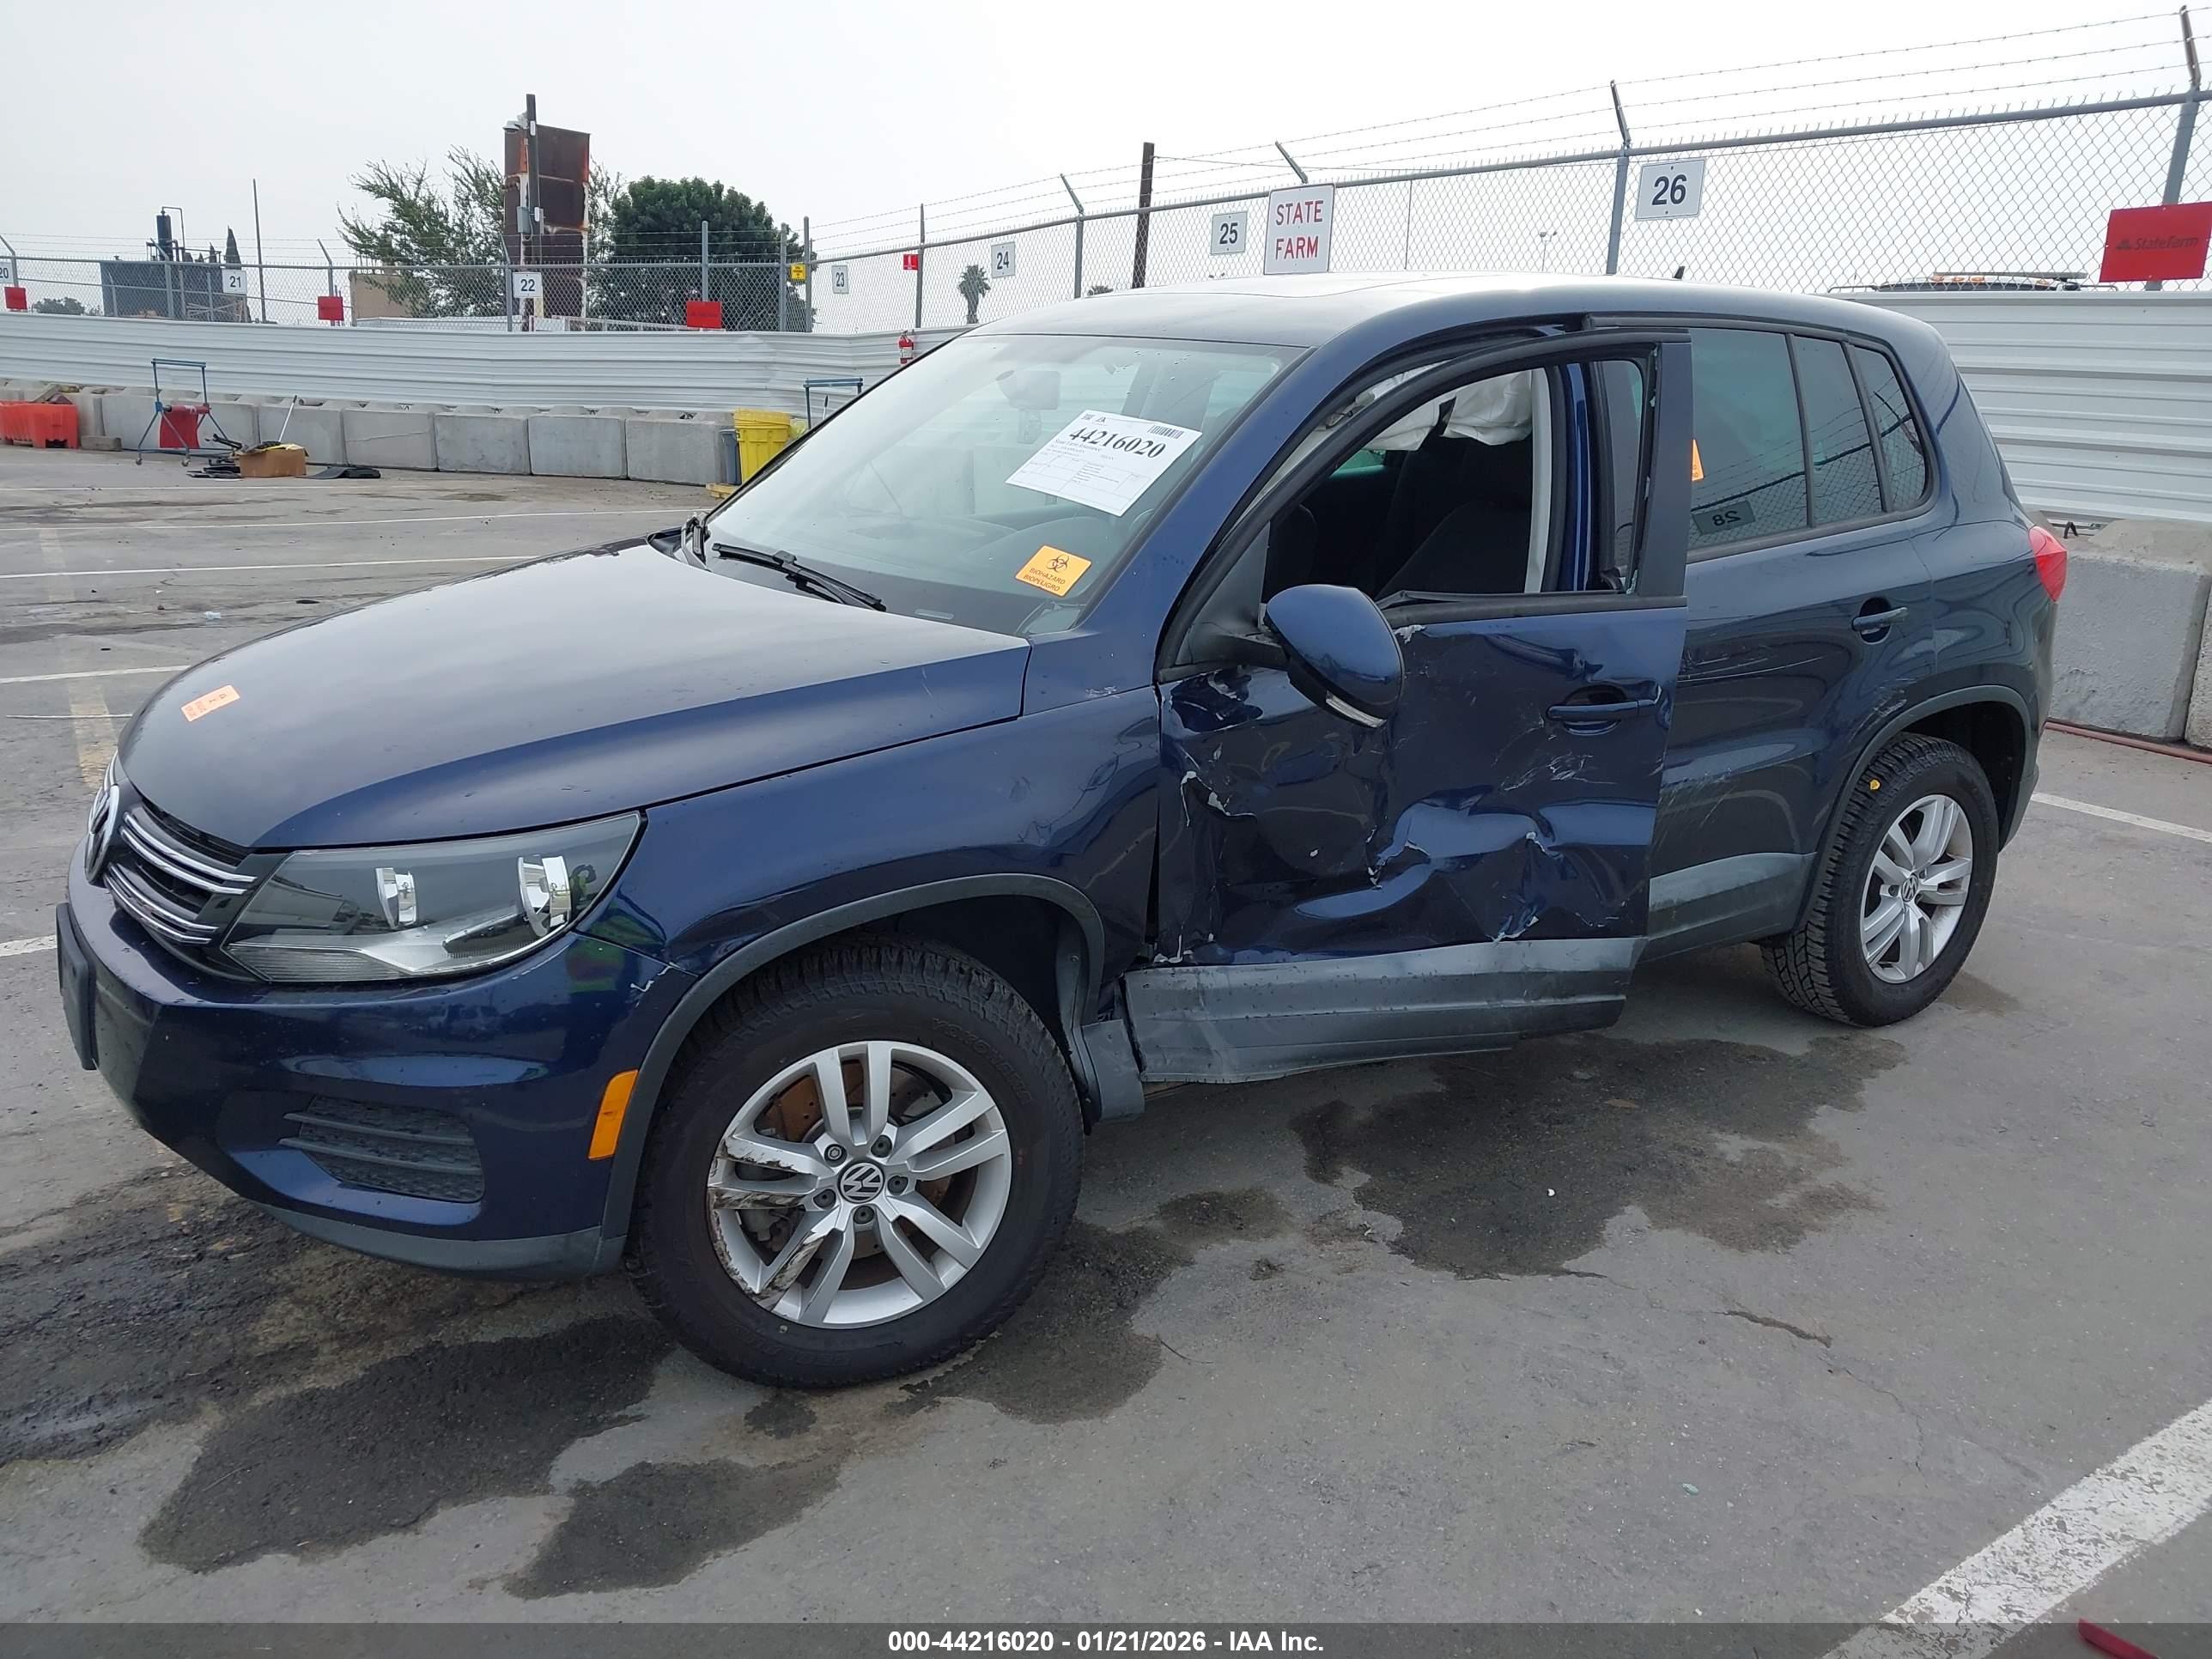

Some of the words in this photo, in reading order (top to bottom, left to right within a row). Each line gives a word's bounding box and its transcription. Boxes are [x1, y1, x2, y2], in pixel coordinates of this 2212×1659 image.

[1651, 174, 1687, 205] 26
[1275, 200, 1324, 226] STATE
[1219, 222, 1238, 245] 25
[1275, 235, 1319, 260] FARM
[996, 252, 1010, 270] 24
[229, 276, 241, 288] 21
[520, 278, 536, 292] 22
[836, 271, 845, 288] 23
[1069, 426, 1166, 459] 44216020
[1029, 568, 1066, 585] BIOHAZARD
